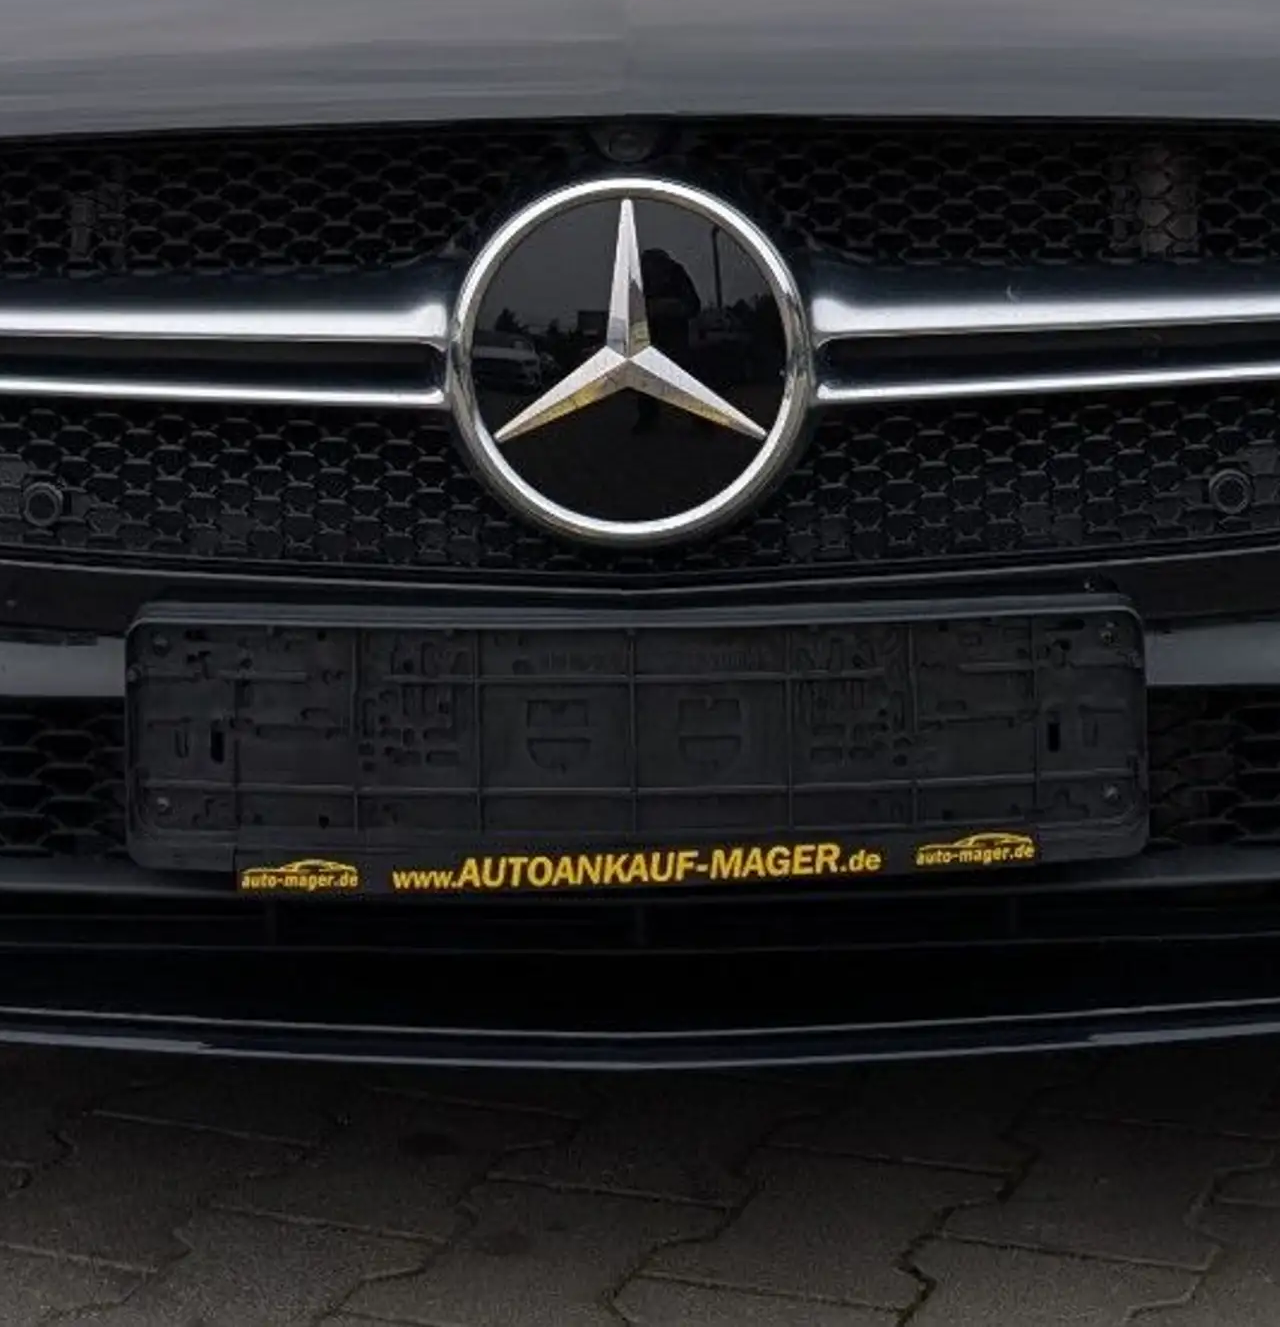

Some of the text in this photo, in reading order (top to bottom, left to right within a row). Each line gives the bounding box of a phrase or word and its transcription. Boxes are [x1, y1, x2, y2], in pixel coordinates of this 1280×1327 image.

[916, 844, 1035, 866] auto-mager.de
[392, 843, 881, 890] www.AUTOANKAUF-MAGER.de
[241, 872, 359, 890] auto-mager.de
